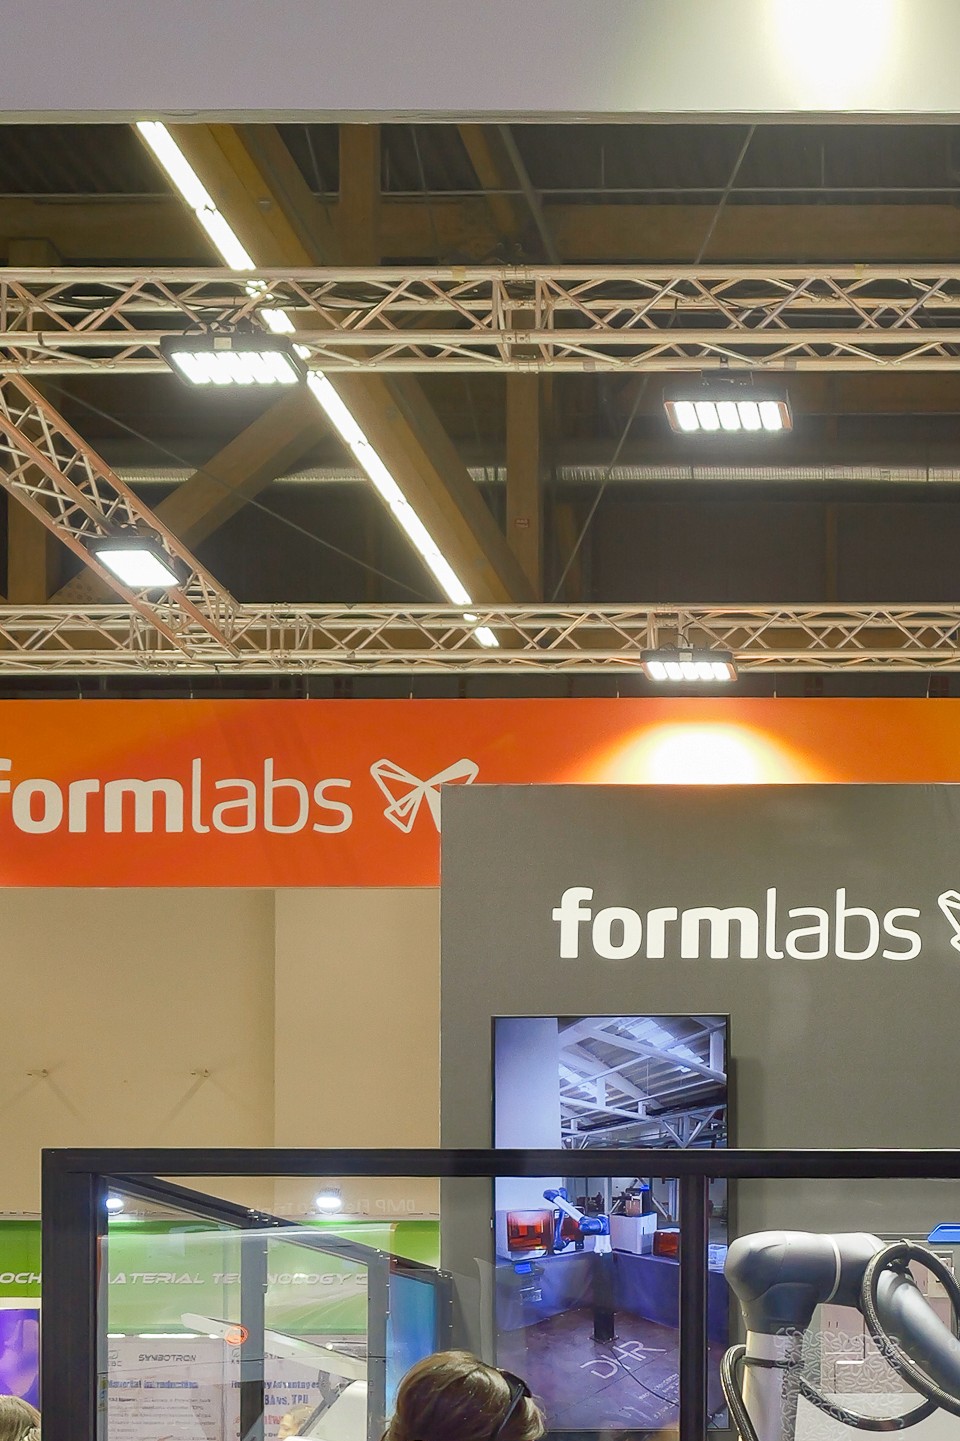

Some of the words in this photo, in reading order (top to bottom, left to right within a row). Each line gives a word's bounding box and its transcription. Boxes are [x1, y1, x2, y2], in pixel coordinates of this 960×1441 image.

[0, 758, 353, 834] ormlabs
[552, 886, 922, 961] formlabs
[212, 1272, 352, 1285] TENOLOGY
[580, 1341, 666, 1379] DHR
